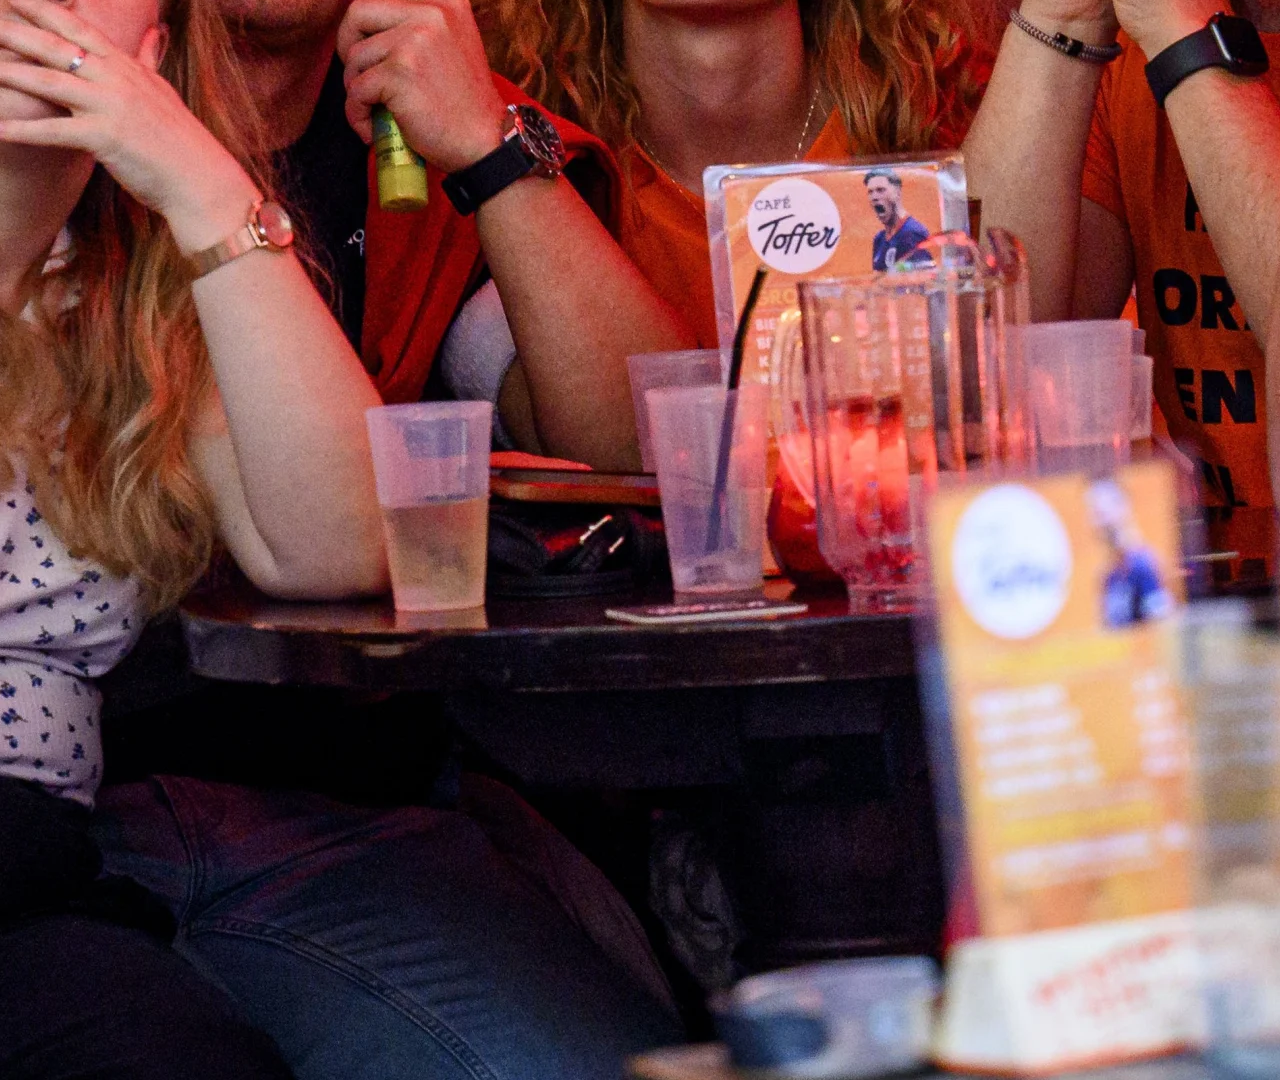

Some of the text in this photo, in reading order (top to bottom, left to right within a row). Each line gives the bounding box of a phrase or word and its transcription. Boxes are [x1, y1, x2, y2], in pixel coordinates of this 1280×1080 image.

[754, 195, 791, 211] CAFÉ
[758, 213, 839, 256] Toffer
[1153, 267, 1251, 332] OR
